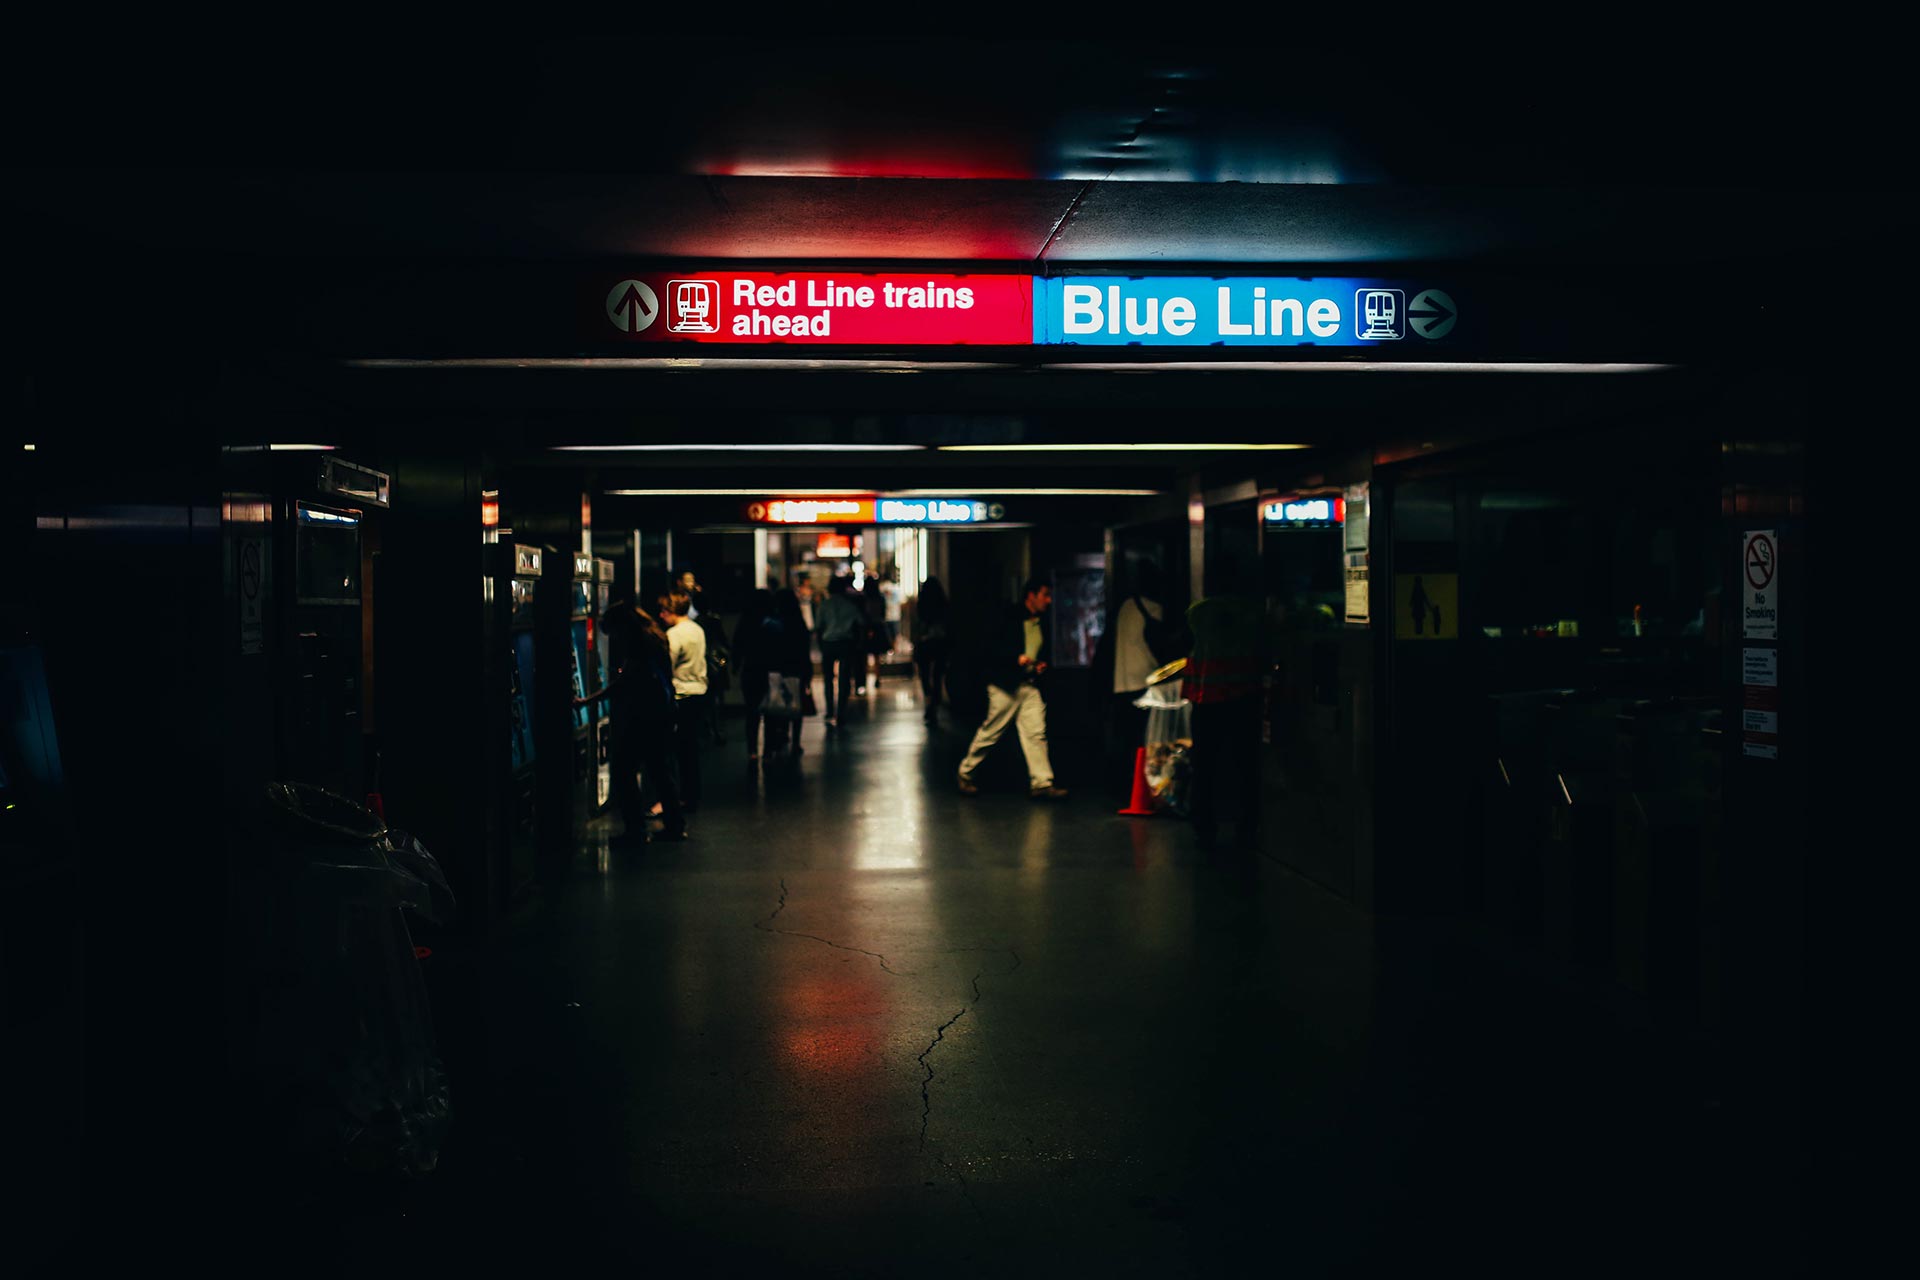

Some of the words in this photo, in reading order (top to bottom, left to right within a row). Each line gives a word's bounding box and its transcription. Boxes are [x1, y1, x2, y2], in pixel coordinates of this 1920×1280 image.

[733, 279, 796, 308] Red
[807, 279, 875, 308] Line
[882, 281, 975, 309] trains
[732, 309, 831, 337] ahead
[1063, 284, 1197, 336] Blue
[1218, 286, 1341, 337] Line
[1755, 592, 1766, 605] No
[1745, 606, 1776, 622] Smoking
